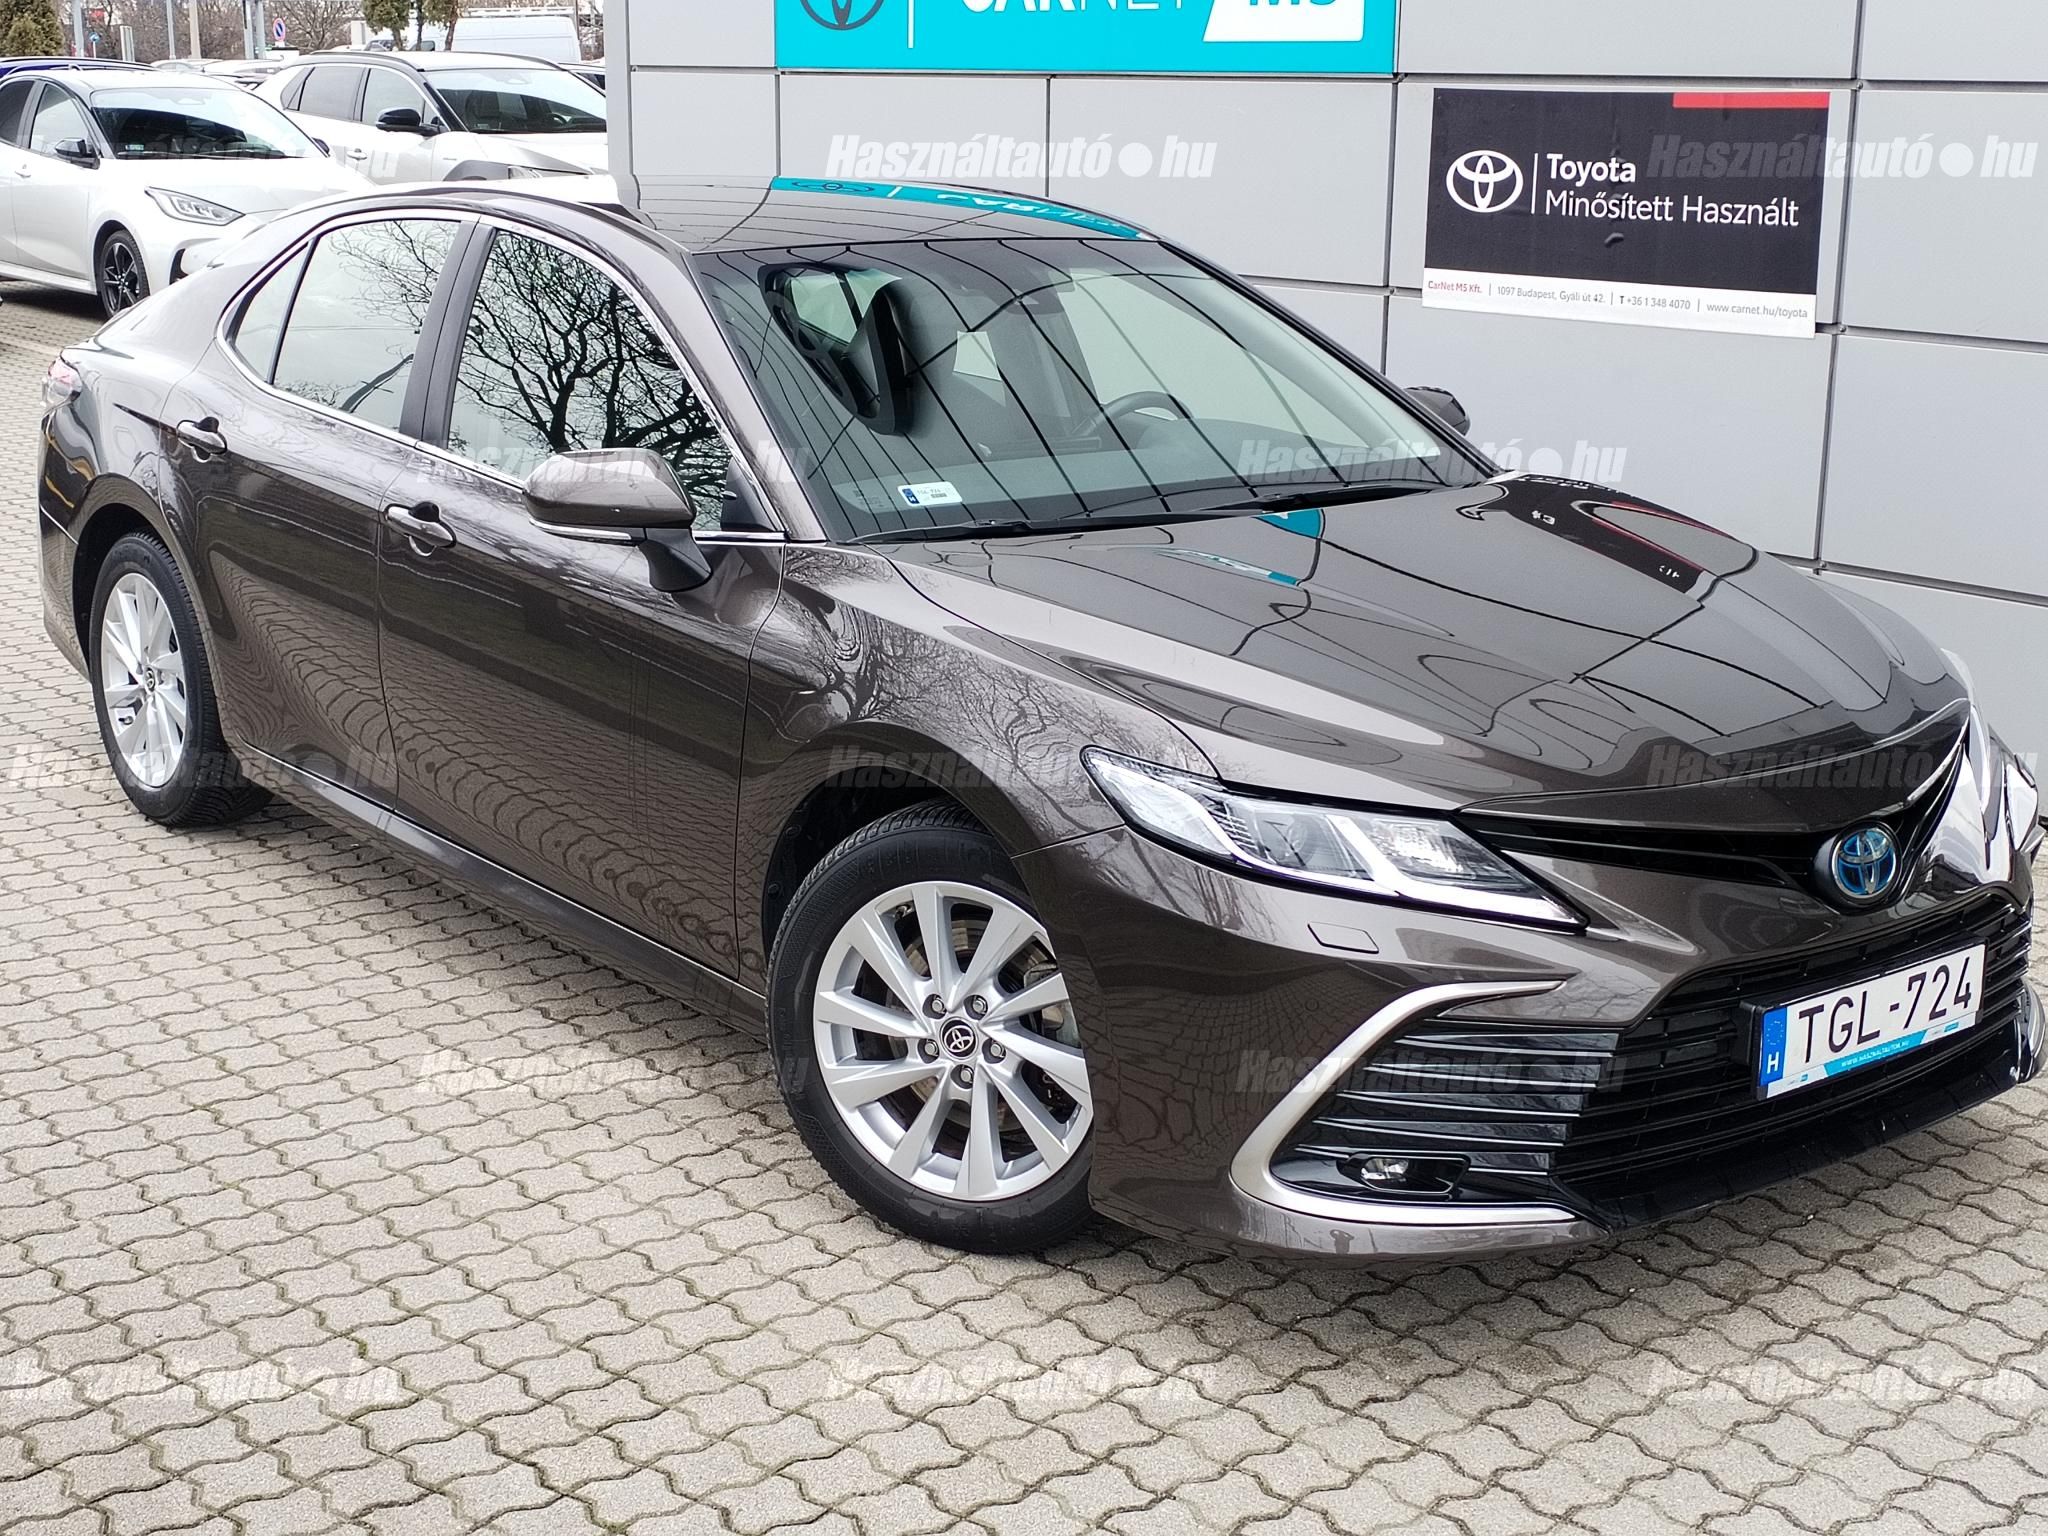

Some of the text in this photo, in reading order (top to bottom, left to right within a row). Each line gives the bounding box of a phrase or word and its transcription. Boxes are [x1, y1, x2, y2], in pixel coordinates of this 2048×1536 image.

[1547, 153, 1636, 187] Toyota
[1546, 189, 1799, 226] Minősített Használt
[1428, 280, 1454, 292] CarNet
[1456, 283, 1468, 293] M5
[1469, 284, 1483, 294] Kft.
[1498, 286, 1515, 296] 1097
[1517, 288, 1557, 300] Budapest,
[1619, 295, 1625, 305] T
[1627, 296, 1642, 306] +36
[1650, 298, 1667, 308] 348
[1669, 299, 1691, 310] 4070
[1706, 303, 1808, 319] www.carnet.hu/toyota
[1799, 957, 1972, 1063] TGL-724
[1766, 1051, 1780, 1075] H
